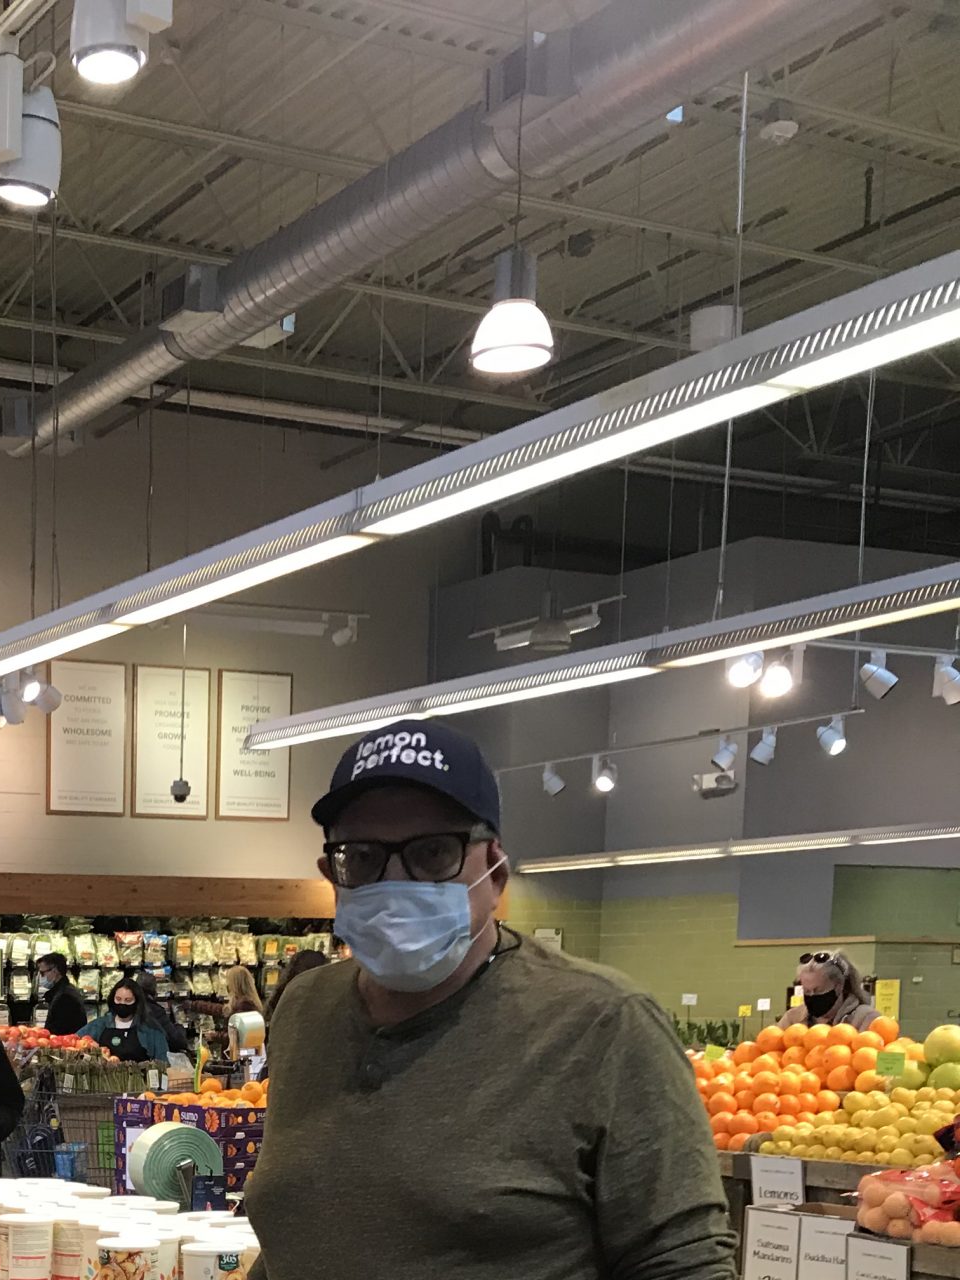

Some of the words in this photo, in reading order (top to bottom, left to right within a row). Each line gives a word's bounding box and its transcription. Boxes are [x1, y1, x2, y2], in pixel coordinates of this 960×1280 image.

[64, 694, 112, 705] COMMITTED
[240, 704, 271, 714] PROVIDE
[62, 727, 112, 738] WHOLESOME
[356, 731, 427, 761] lemon
[351, 746, 450, 781] perfect.
[759, 1186, 799, 1201] Lemons
[757, 1238, 789, 1252] Satsuma
[753, 1250, 792, 1265] Mandarins
